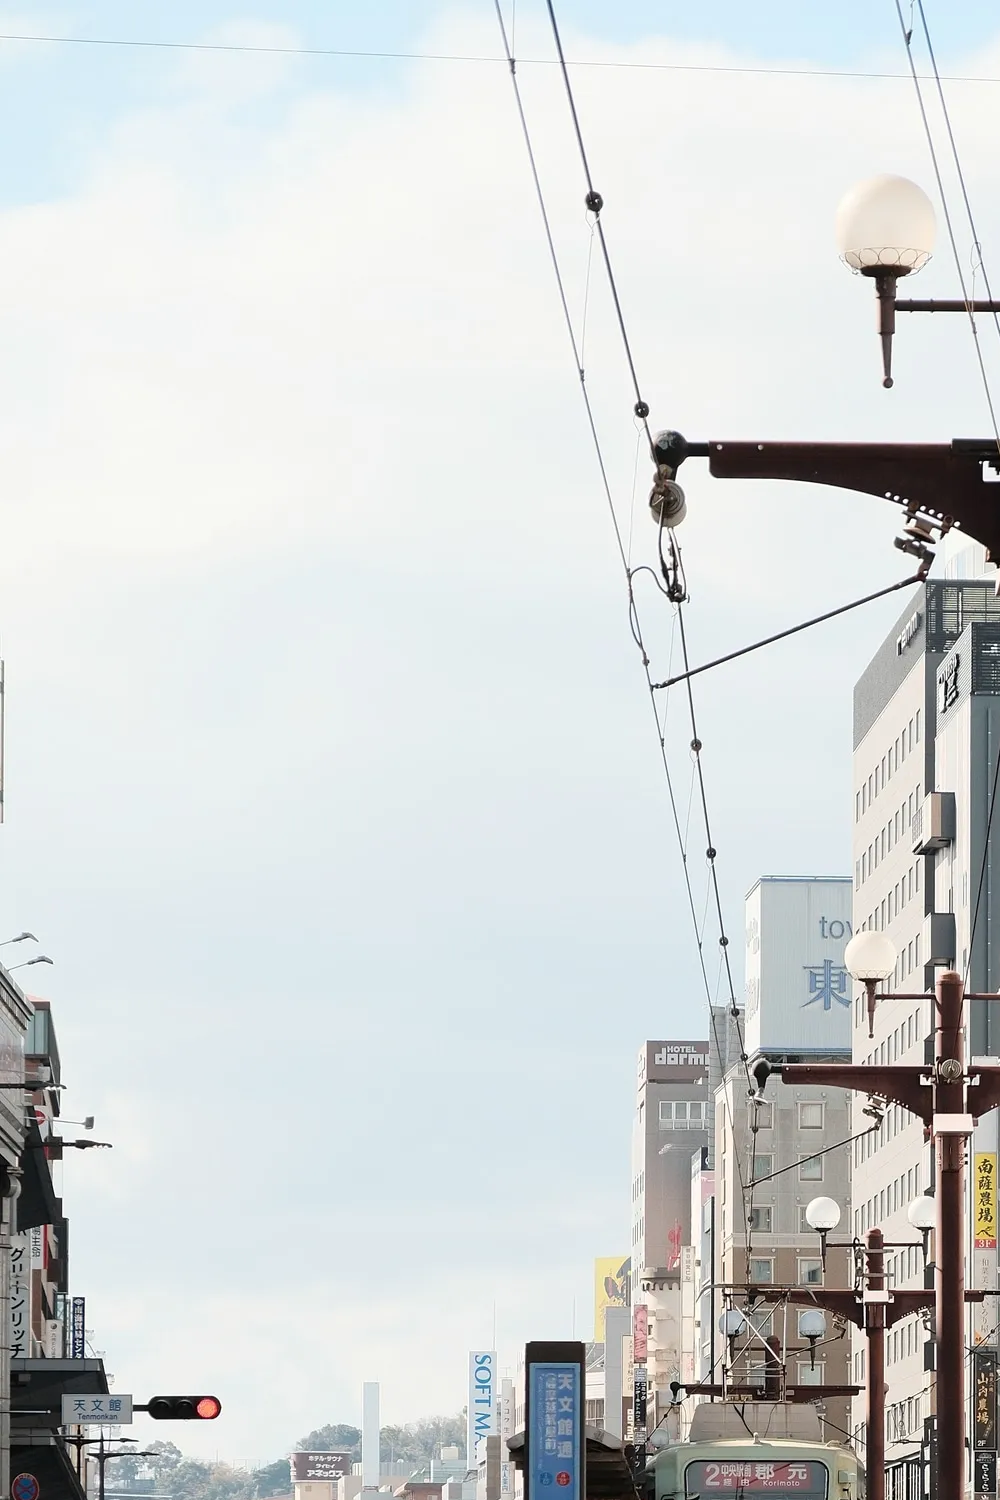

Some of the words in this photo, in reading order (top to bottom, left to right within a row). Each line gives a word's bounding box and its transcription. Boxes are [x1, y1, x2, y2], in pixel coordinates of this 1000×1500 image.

[800, 958, 852, 1011] 東
[667, 1045, 697, 1053] HOTEL
[979, 1240, 992, 1248] 3F
[10, 1246, 25, 1359] グリーンリッチ
[475, 1354, 492, 1408] SOFT
[73, 1399, 122, 1411] 天文館
[558, 1373, 573, 1458] 天文館通
[475, 1411, 491, 1460] MA
[306, 1469, 344, 1478] アネックス
[706, 1464, 720, 1486] 2
[721, 1464, 752, 1477] 中央駅前
[723, 1478, 750, 1487] 経由
